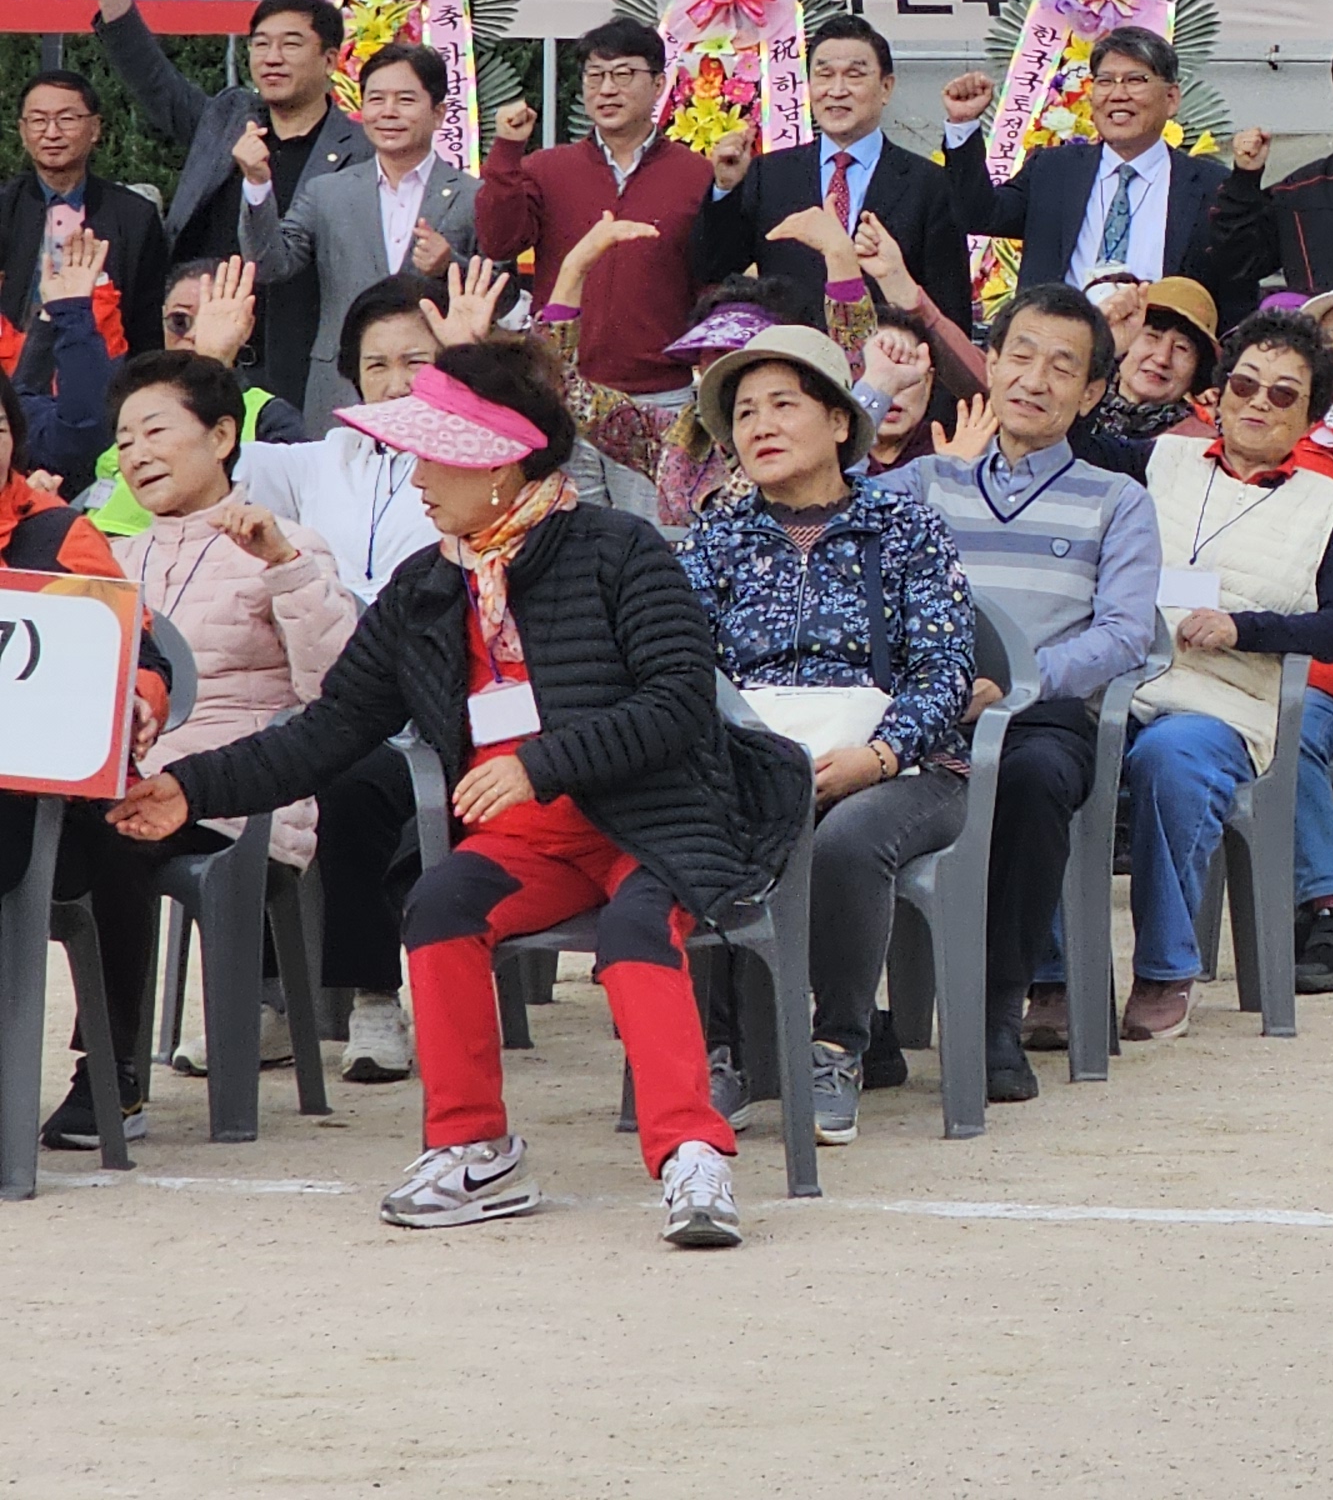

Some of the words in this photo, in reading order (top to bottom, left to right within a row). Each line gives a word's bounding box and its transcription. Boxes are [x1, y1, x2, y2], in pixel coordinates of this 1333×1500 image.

[432, 4, 463, 32] 축
[770, 35, 801, 63] 祝
[772, 71, 806, 147] 하남시
